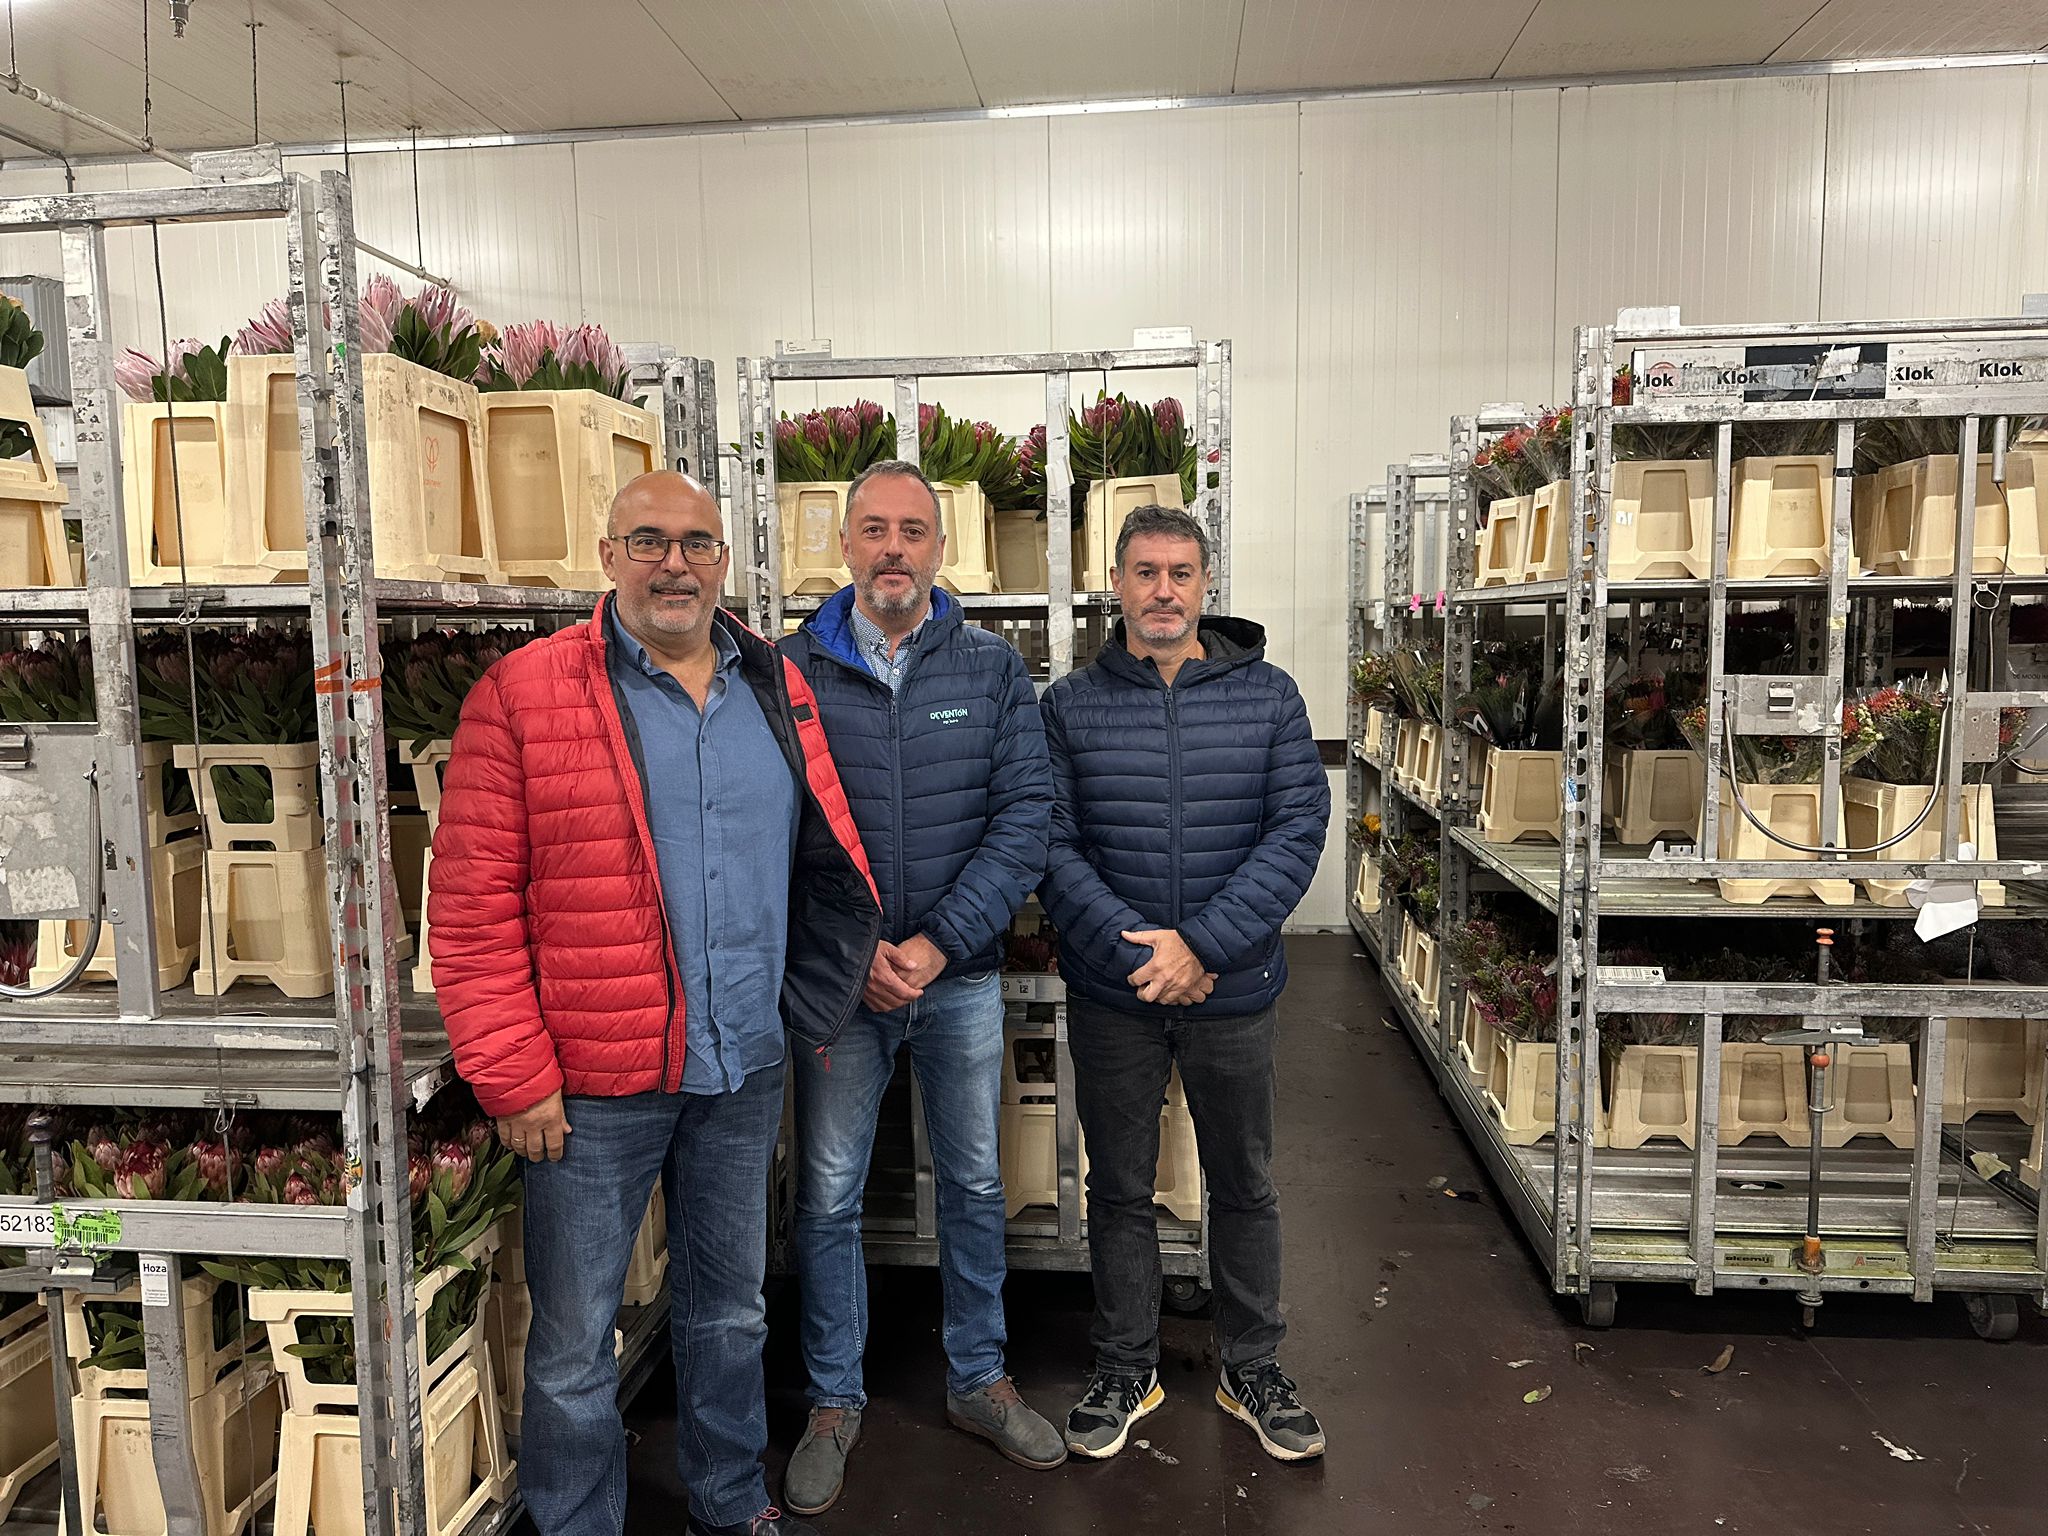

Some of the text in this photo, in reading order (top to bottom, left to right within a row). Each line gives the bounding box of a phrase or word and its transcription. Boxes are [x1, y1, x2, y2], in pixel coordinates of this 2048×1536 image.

[1717, 370, 1760, 385] Klok
[1979, 362, 2023, 378] Klok
[143, 1263, 167, 1272] Hoza
